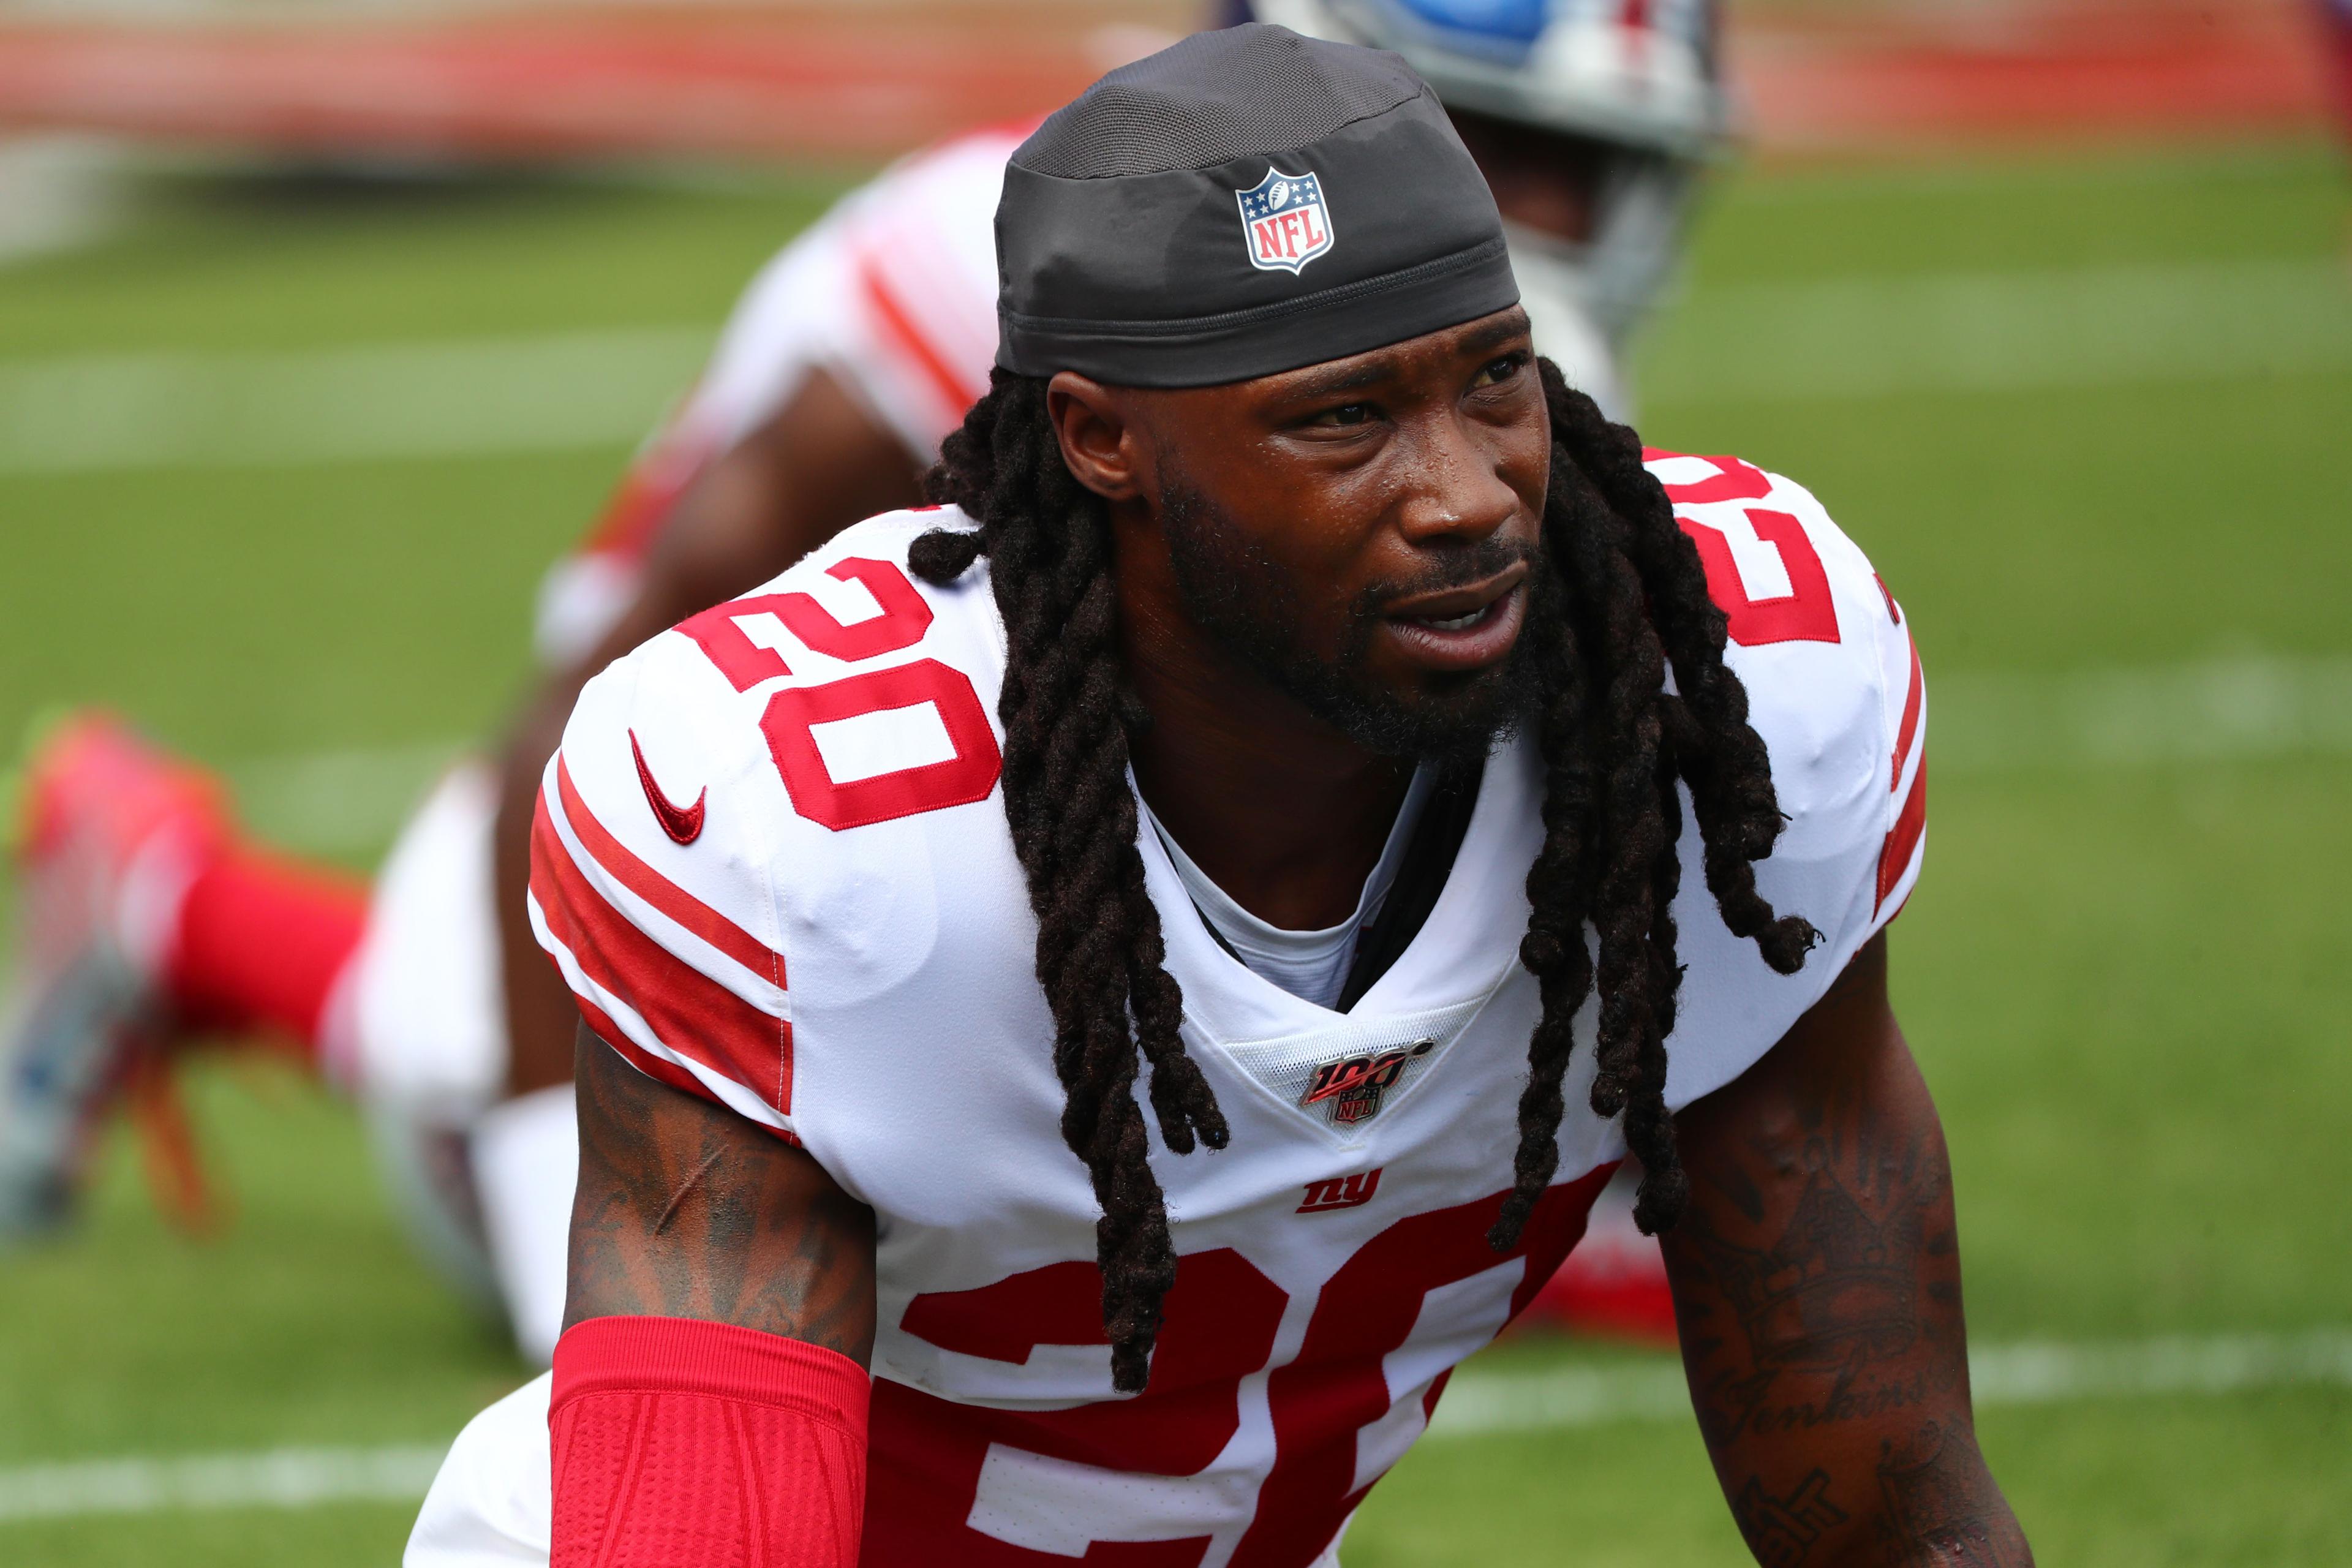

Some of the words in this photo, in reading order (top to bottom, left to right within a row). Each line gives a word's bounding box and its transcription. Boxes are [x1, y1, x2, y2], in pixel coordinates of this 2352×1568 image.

[1254, 209, 1324, 259] NFL
[672, 556, 1003, 832] 20
[1306, 1052, 1408, 1098] 100
[1339, 1099, 1371, 1120] NFL
